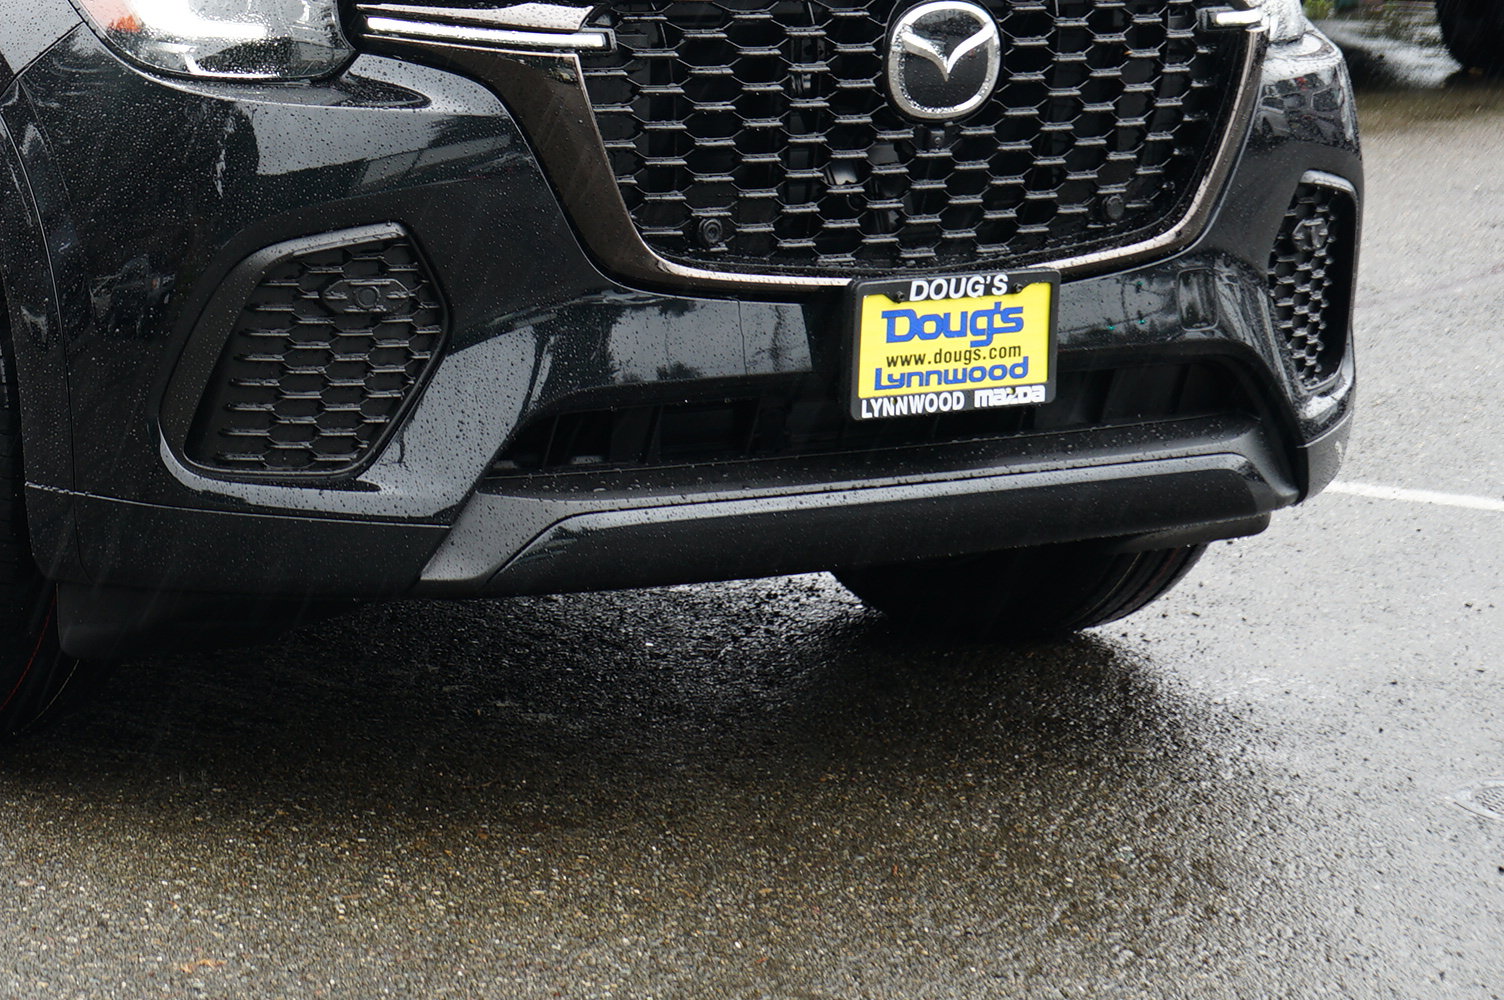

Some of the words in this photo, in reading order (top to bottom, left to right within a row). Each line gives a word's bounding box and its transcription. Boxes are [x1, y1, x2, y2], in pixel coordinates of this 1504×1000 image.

[909, 274, 1009, 302] DOUG'S
[881, 301, 1024, 348] Doug's
[886, 345, 1022, 368] www.dougs.com
[874, 356, 1029, 390] Lynnwood
[861, 391, 965, 419] LYNNWOOD
